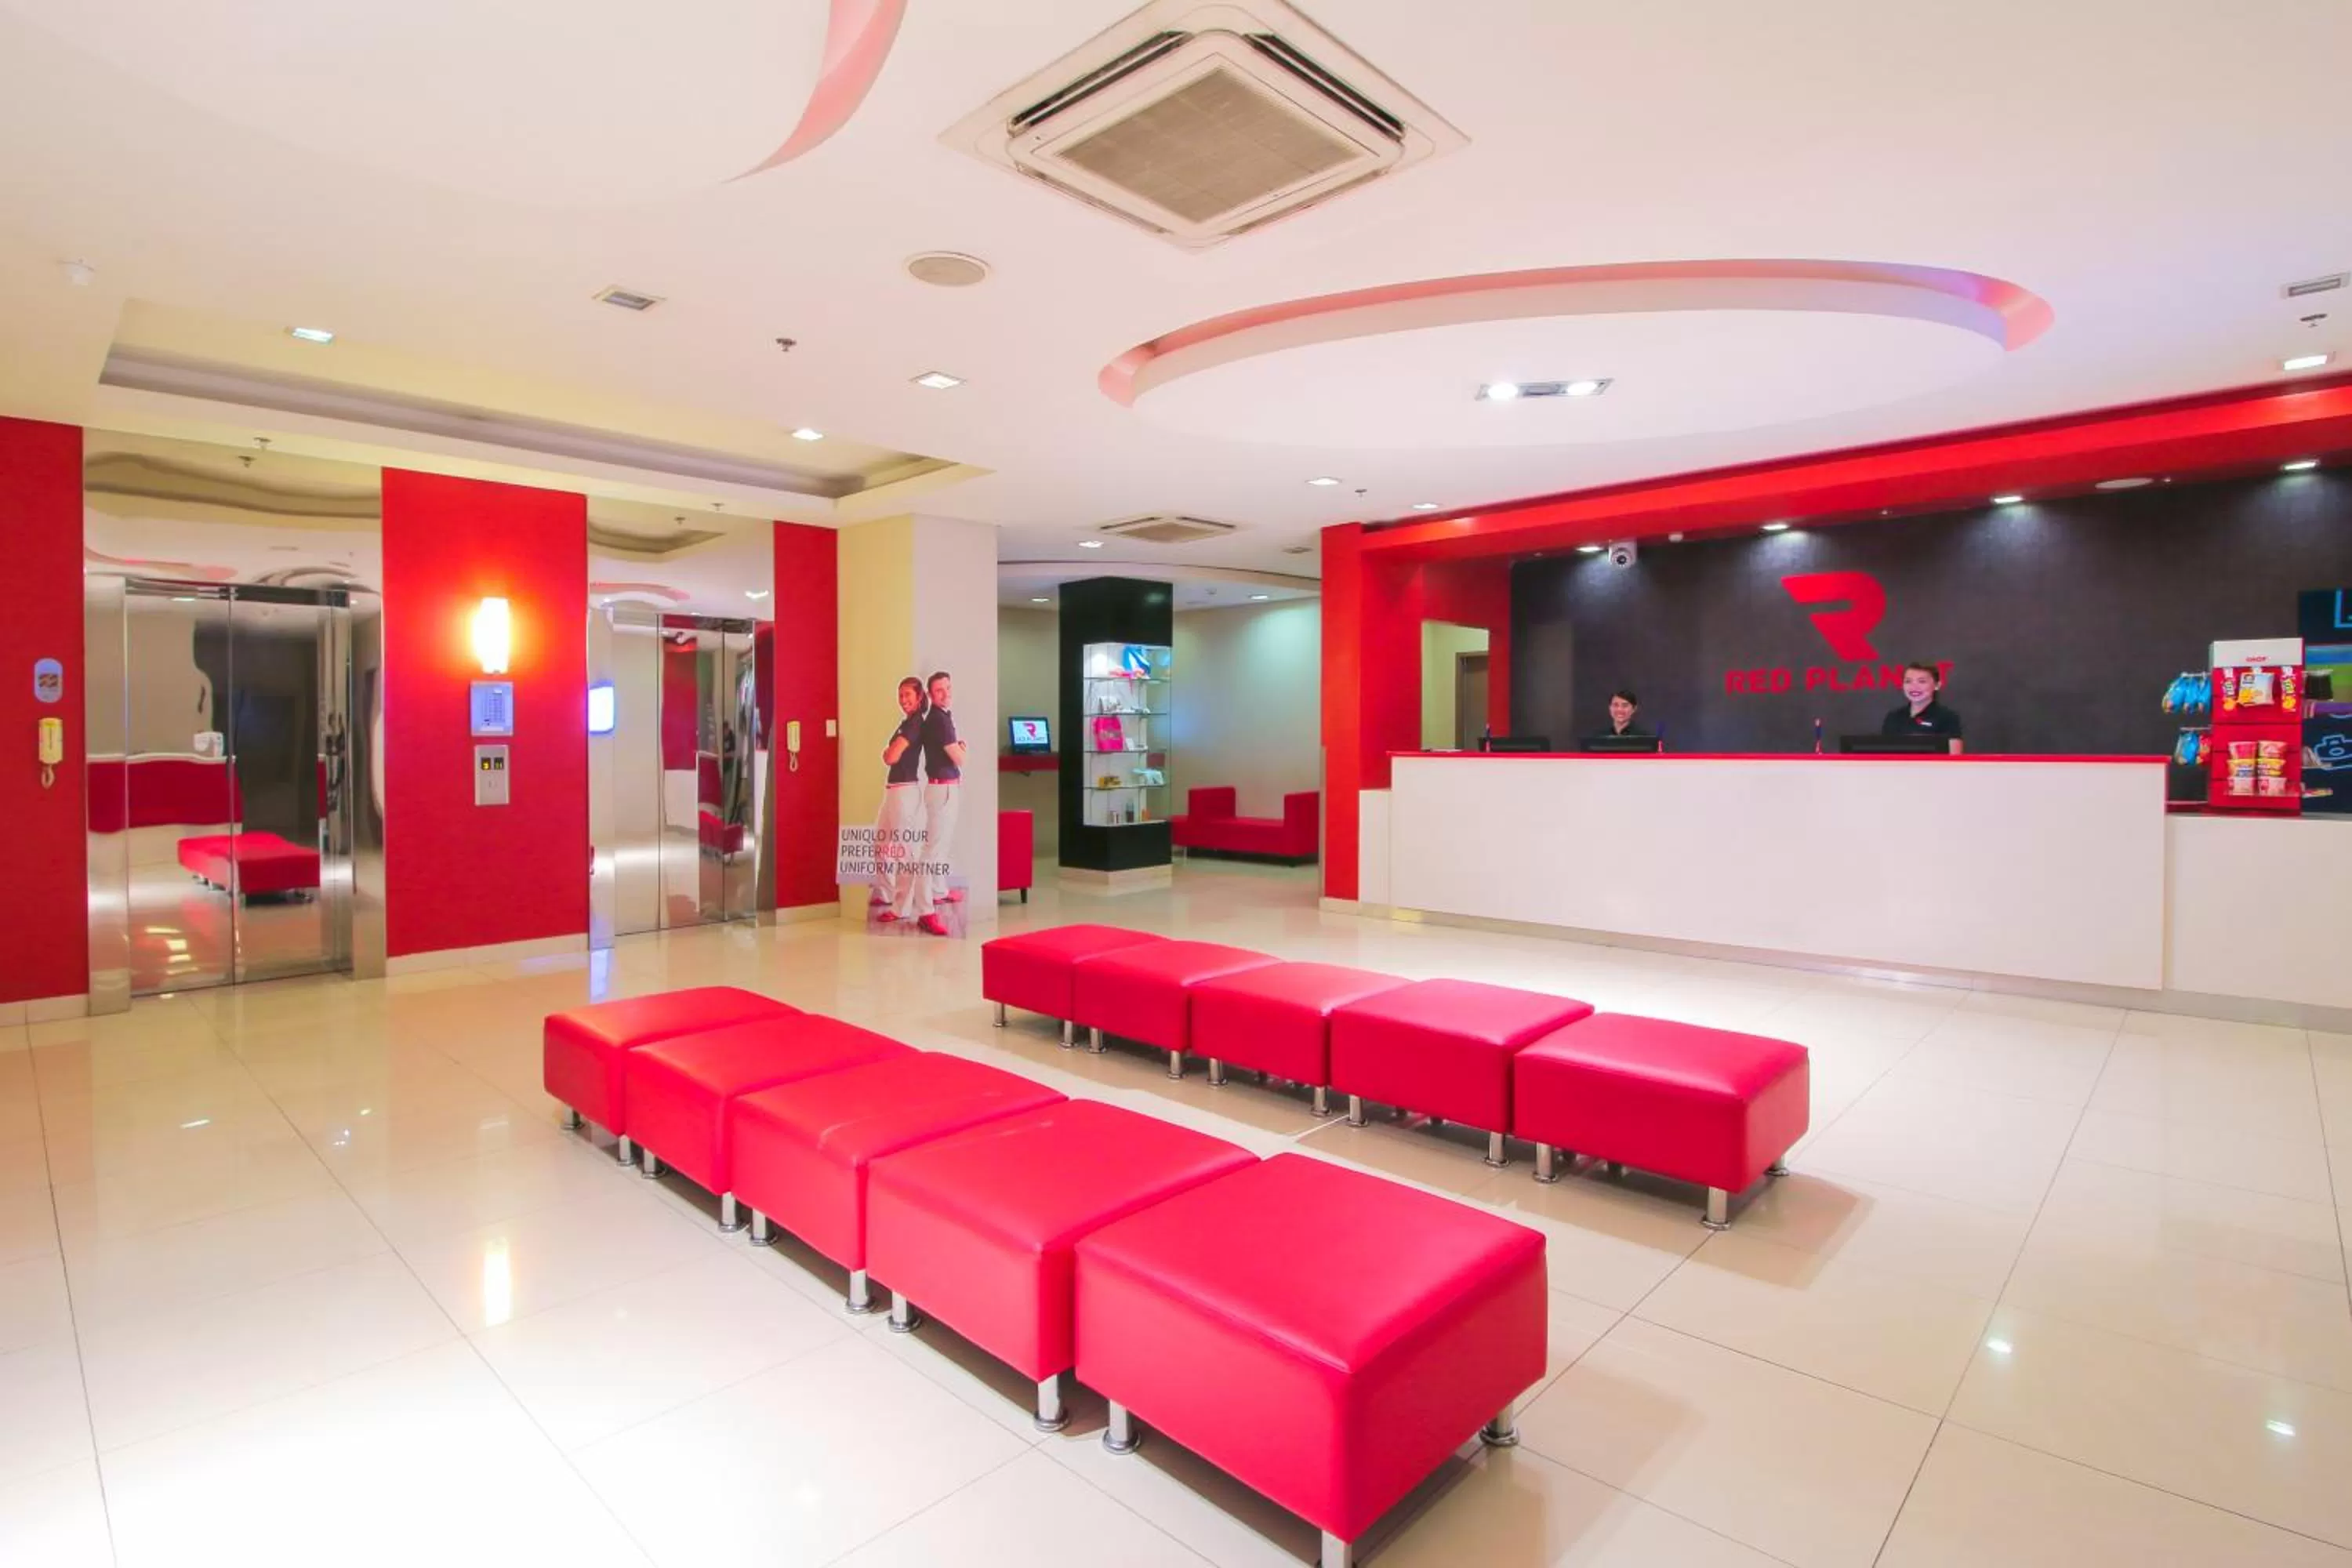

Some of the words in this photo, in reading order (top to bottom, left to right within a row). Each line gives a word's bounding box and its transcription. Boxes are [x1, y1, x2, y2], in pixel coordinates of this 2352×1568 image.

[1780, 572, 1886, 661] R
[1726, 667, 1792, 695] RED
[1806, 662, 1955, 691] PLANT
[841, 829, 886, 844] UNIQLO
[890, 829, 899, 842] IS
[902, 830, 929, 842] OUR
[841, 845, 906, 858] PREFERRED
[840, 862, 893, 873] UNIFORM
[898, 862, 950, 876] PARTNER
